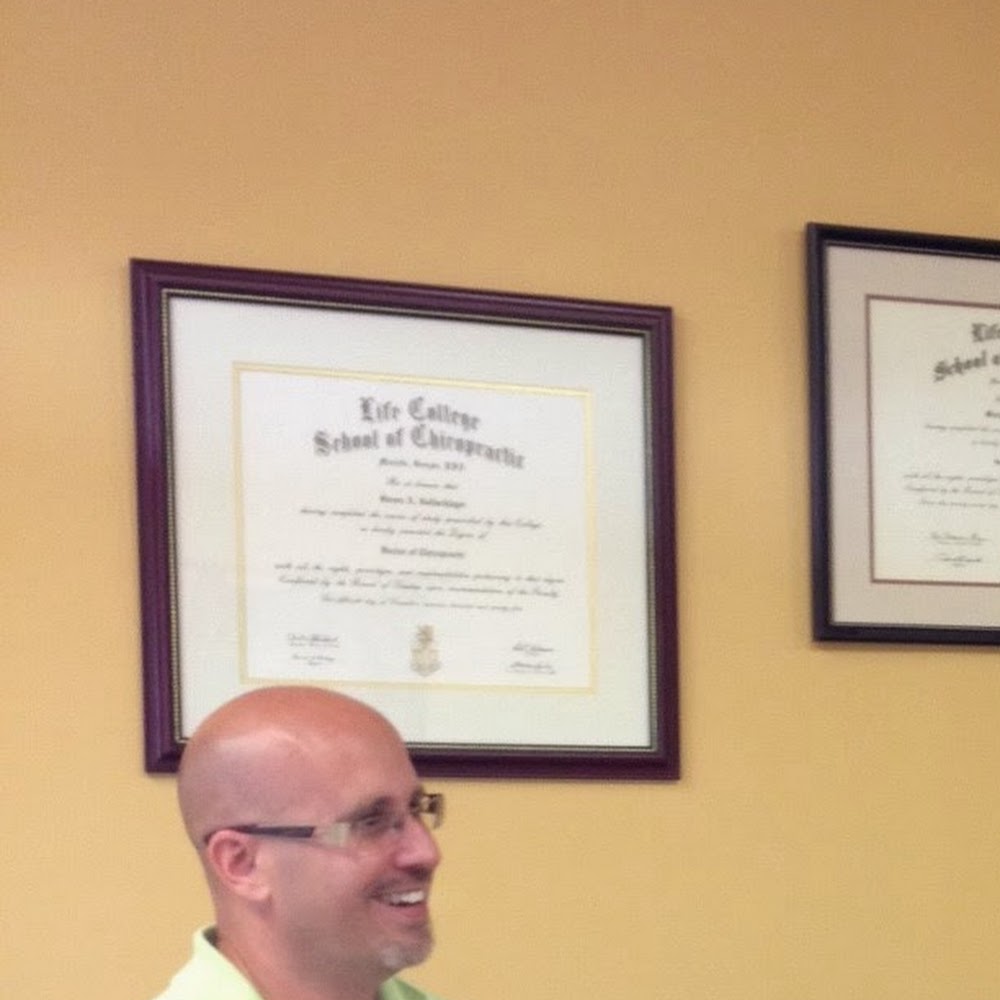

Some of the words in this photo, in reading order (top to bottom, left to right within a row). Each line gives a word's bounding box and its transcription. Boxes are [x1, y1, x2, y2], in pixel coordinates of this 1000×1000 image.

[933, 350, 988, 382] School
[359, 396, 401, 422] Life
[408, 395, 481, 431] College
[313, 429, 379, 457] School
[386, 427, 405, 447] of
[410, 424, 526, 469] Chiropractic
